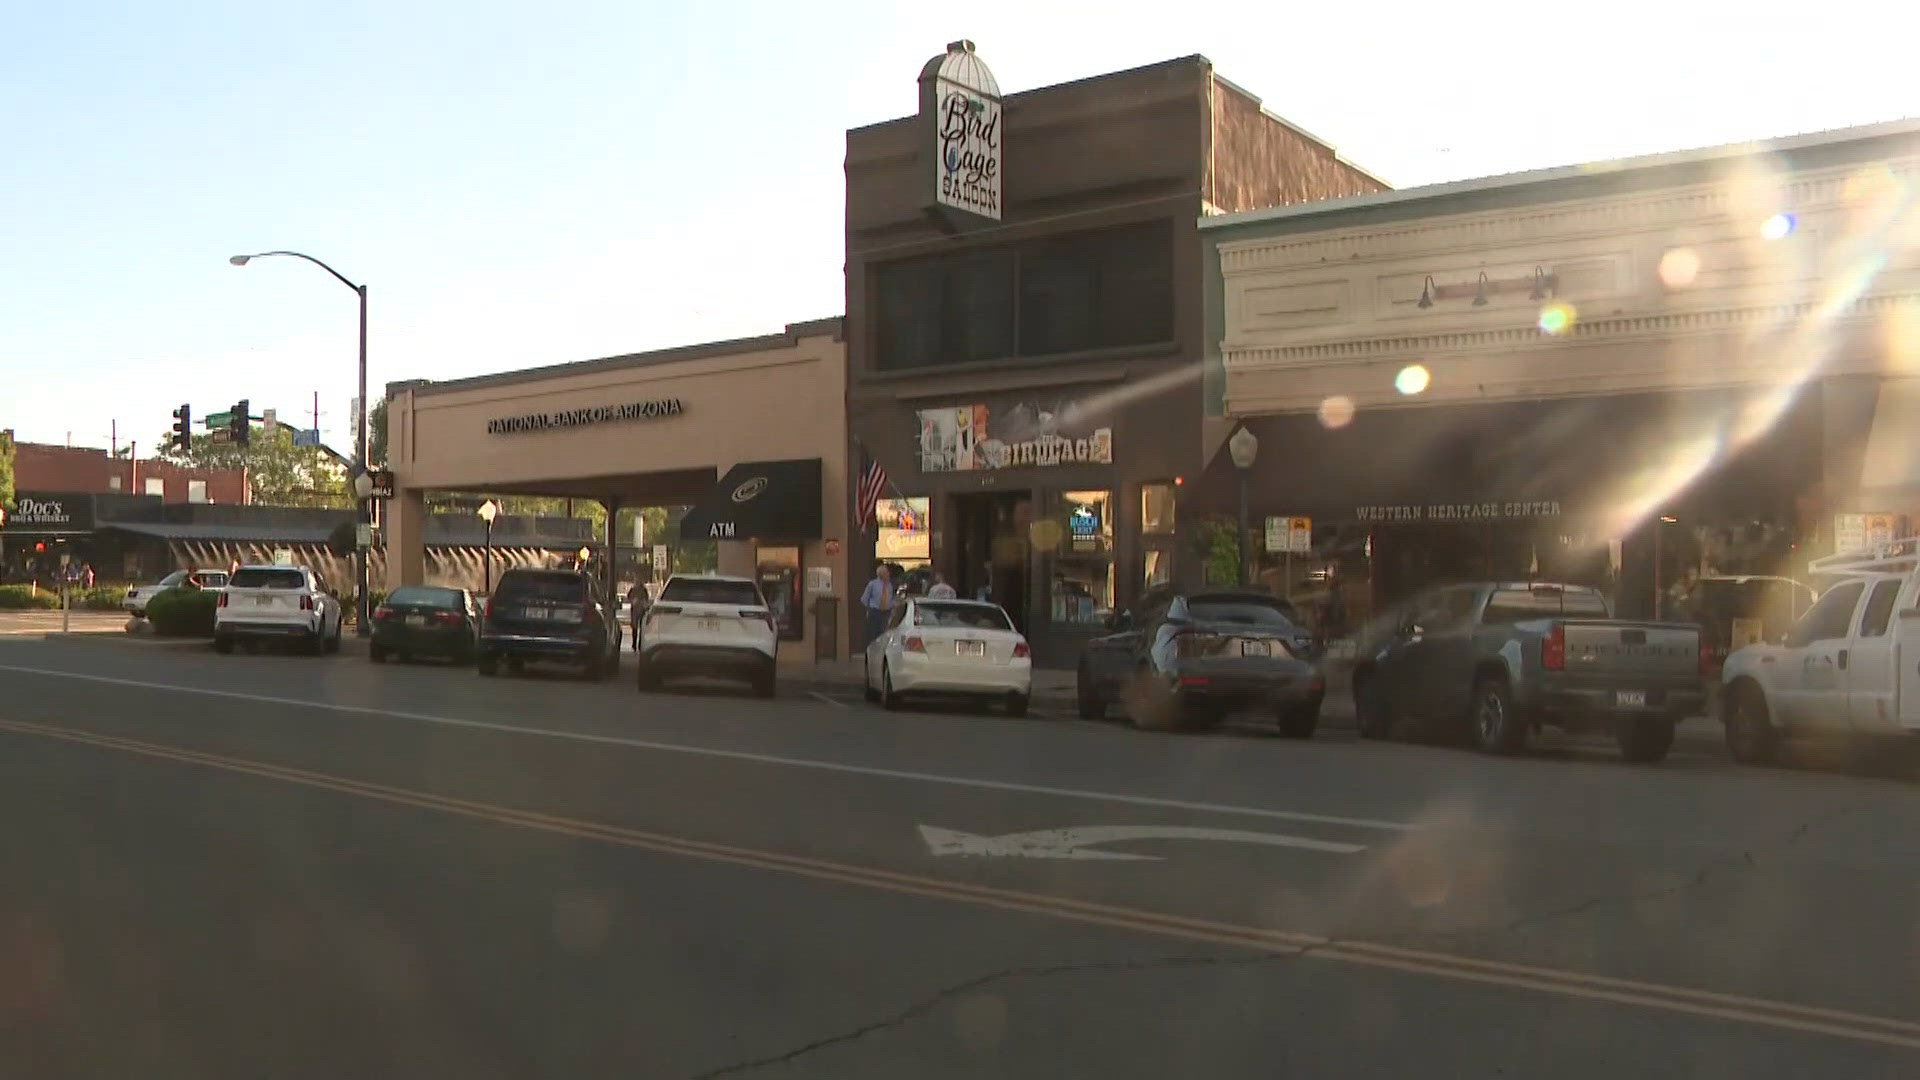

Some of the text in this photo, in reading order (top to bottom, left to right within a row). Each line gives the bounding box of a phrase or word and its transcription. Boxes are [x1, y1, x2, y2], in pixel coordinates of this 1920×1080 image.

[941, 91, 997, 148] Bird
[943, 138, 997, 184] Cage
[943, 176, 997, 210] SALOON
[488, 398, 684, 434] NATIONAL BANK OF ARIZONA
[18, 499, 62, 515] Doc's
[1357, 501, 1561, 521] WESTERN HERITAGE CENTER
[709, 521, 735, 538] ATM
